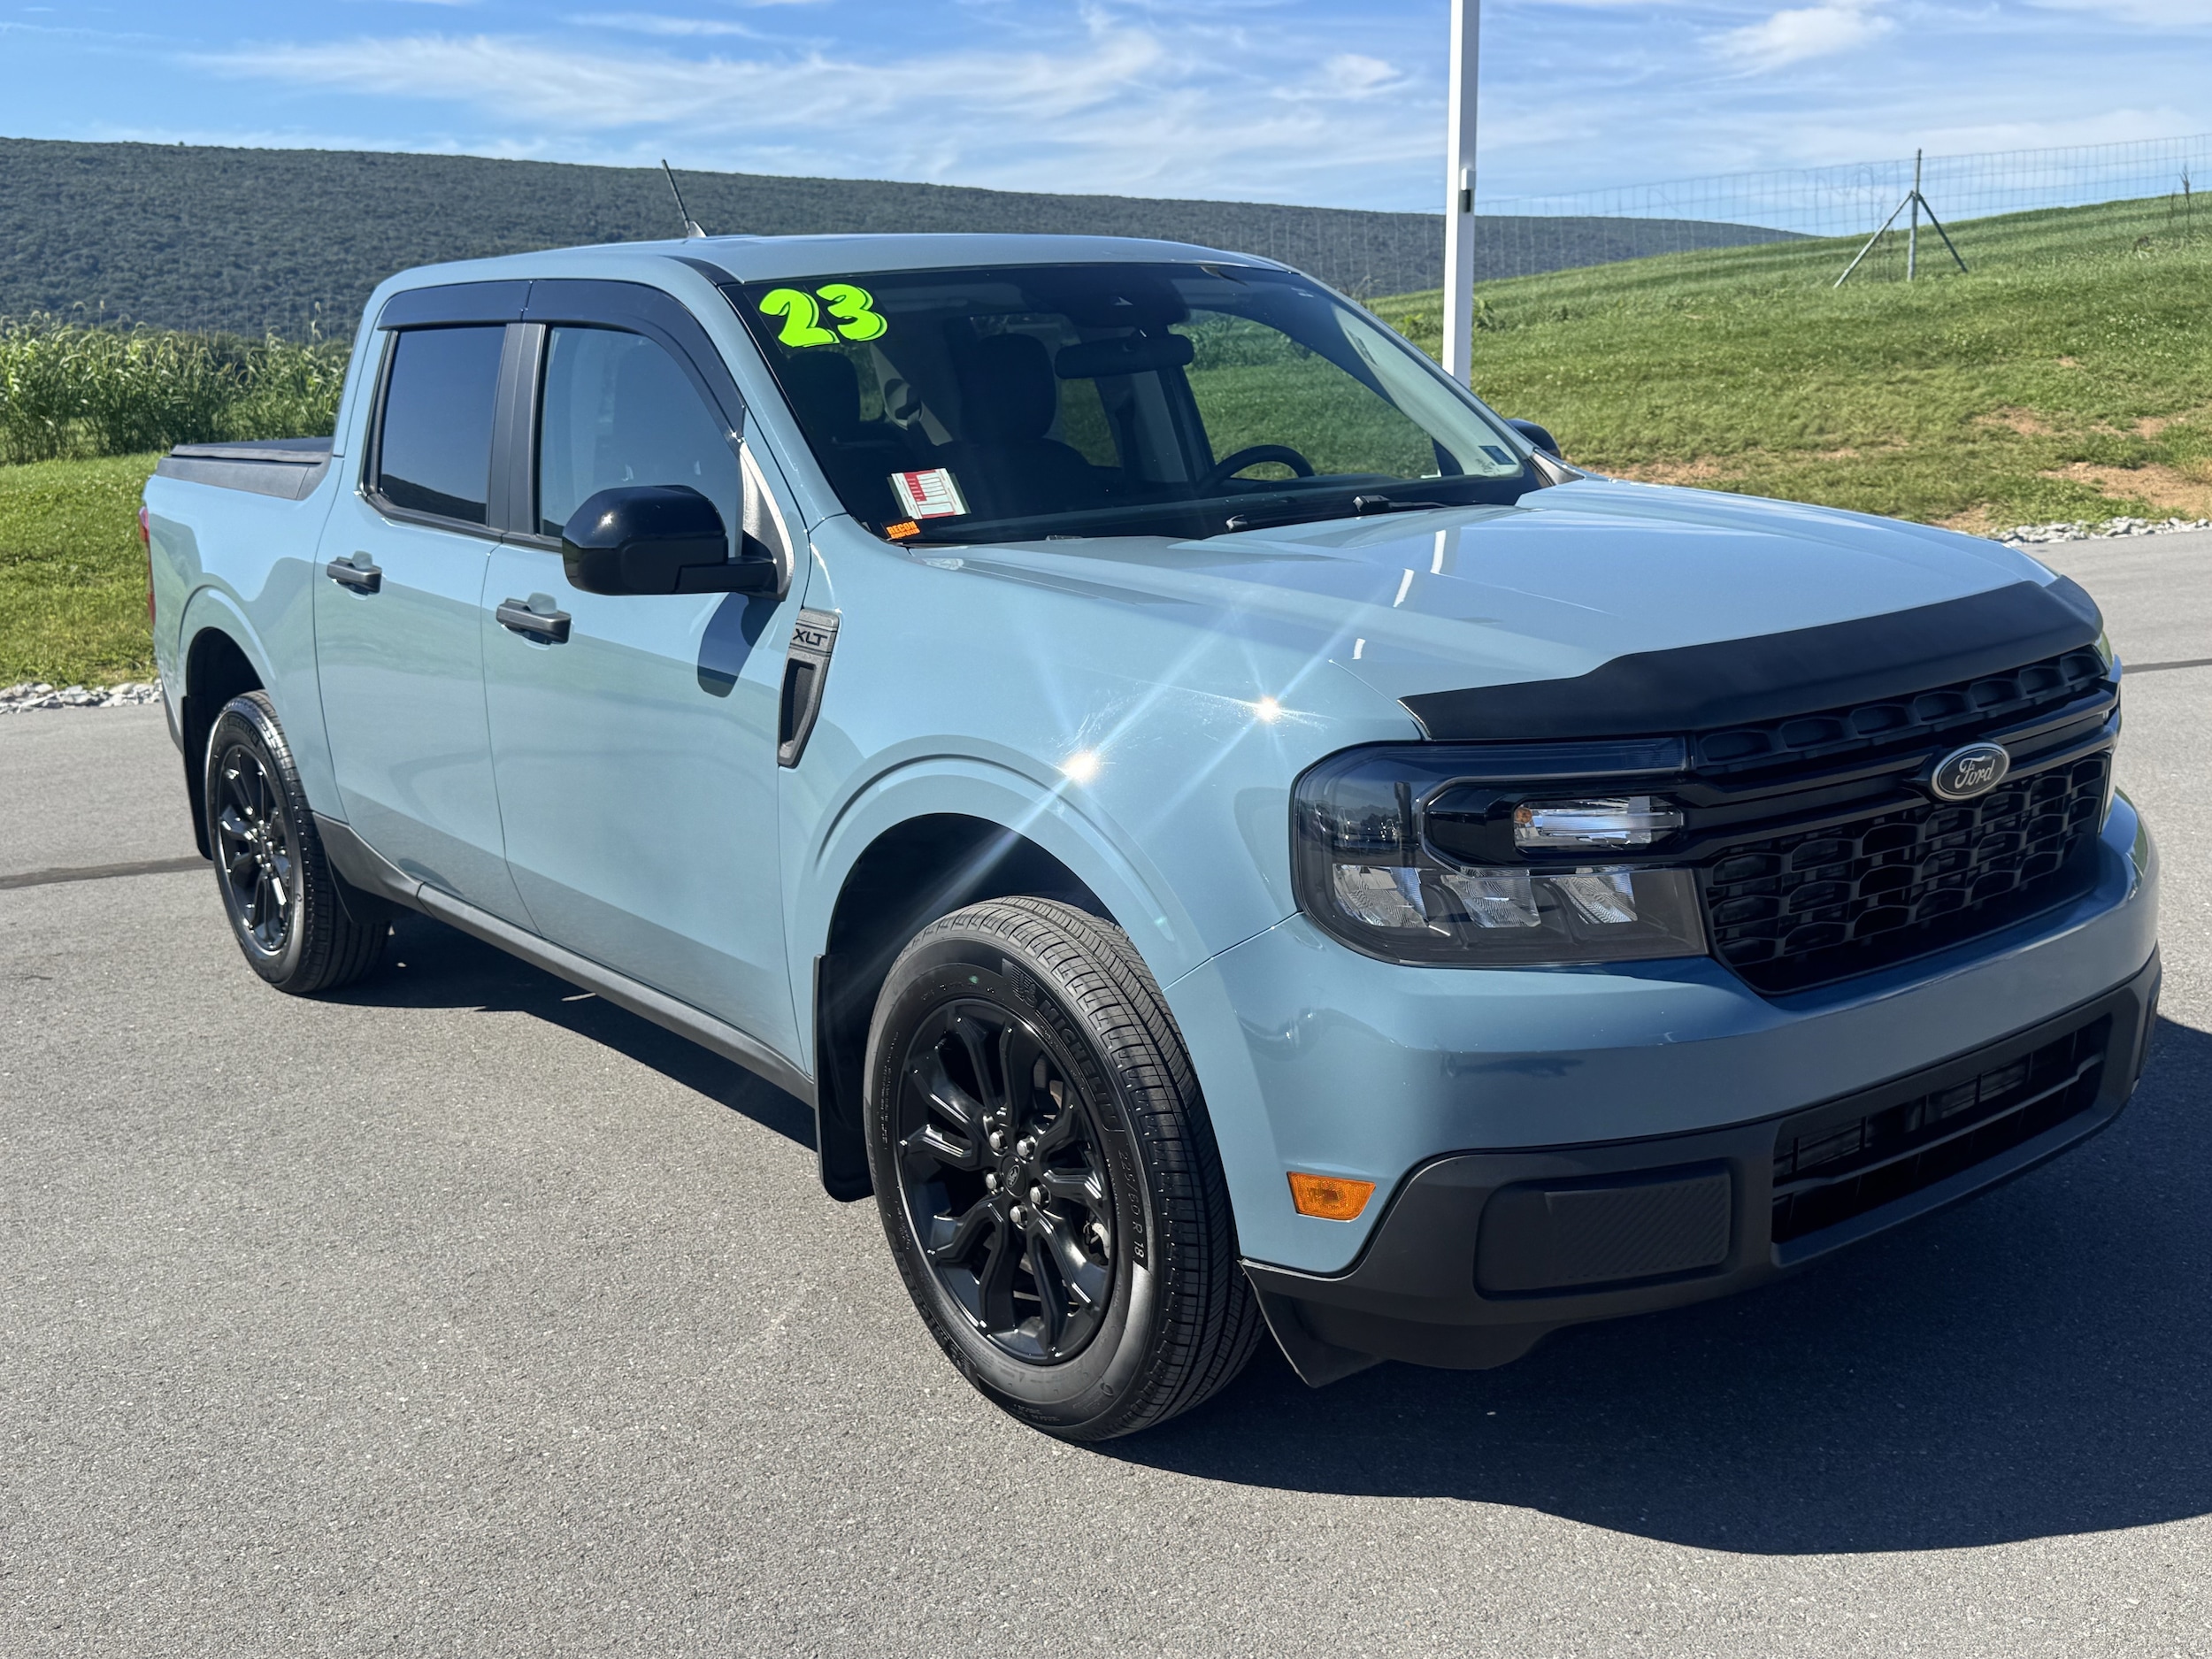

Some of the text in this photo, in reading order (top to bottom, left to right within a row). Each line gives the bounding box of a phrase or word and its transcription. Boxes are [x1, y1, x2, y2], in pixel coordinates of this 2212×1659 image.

[759, 283, 888, 348] 23
[886, 520, 918, 535] RECON
[792, 628, 828, 647] XLT
[1954, 755, 1997, 789] Ford
[1038, 999, 1120, 1125] MICHELIN
